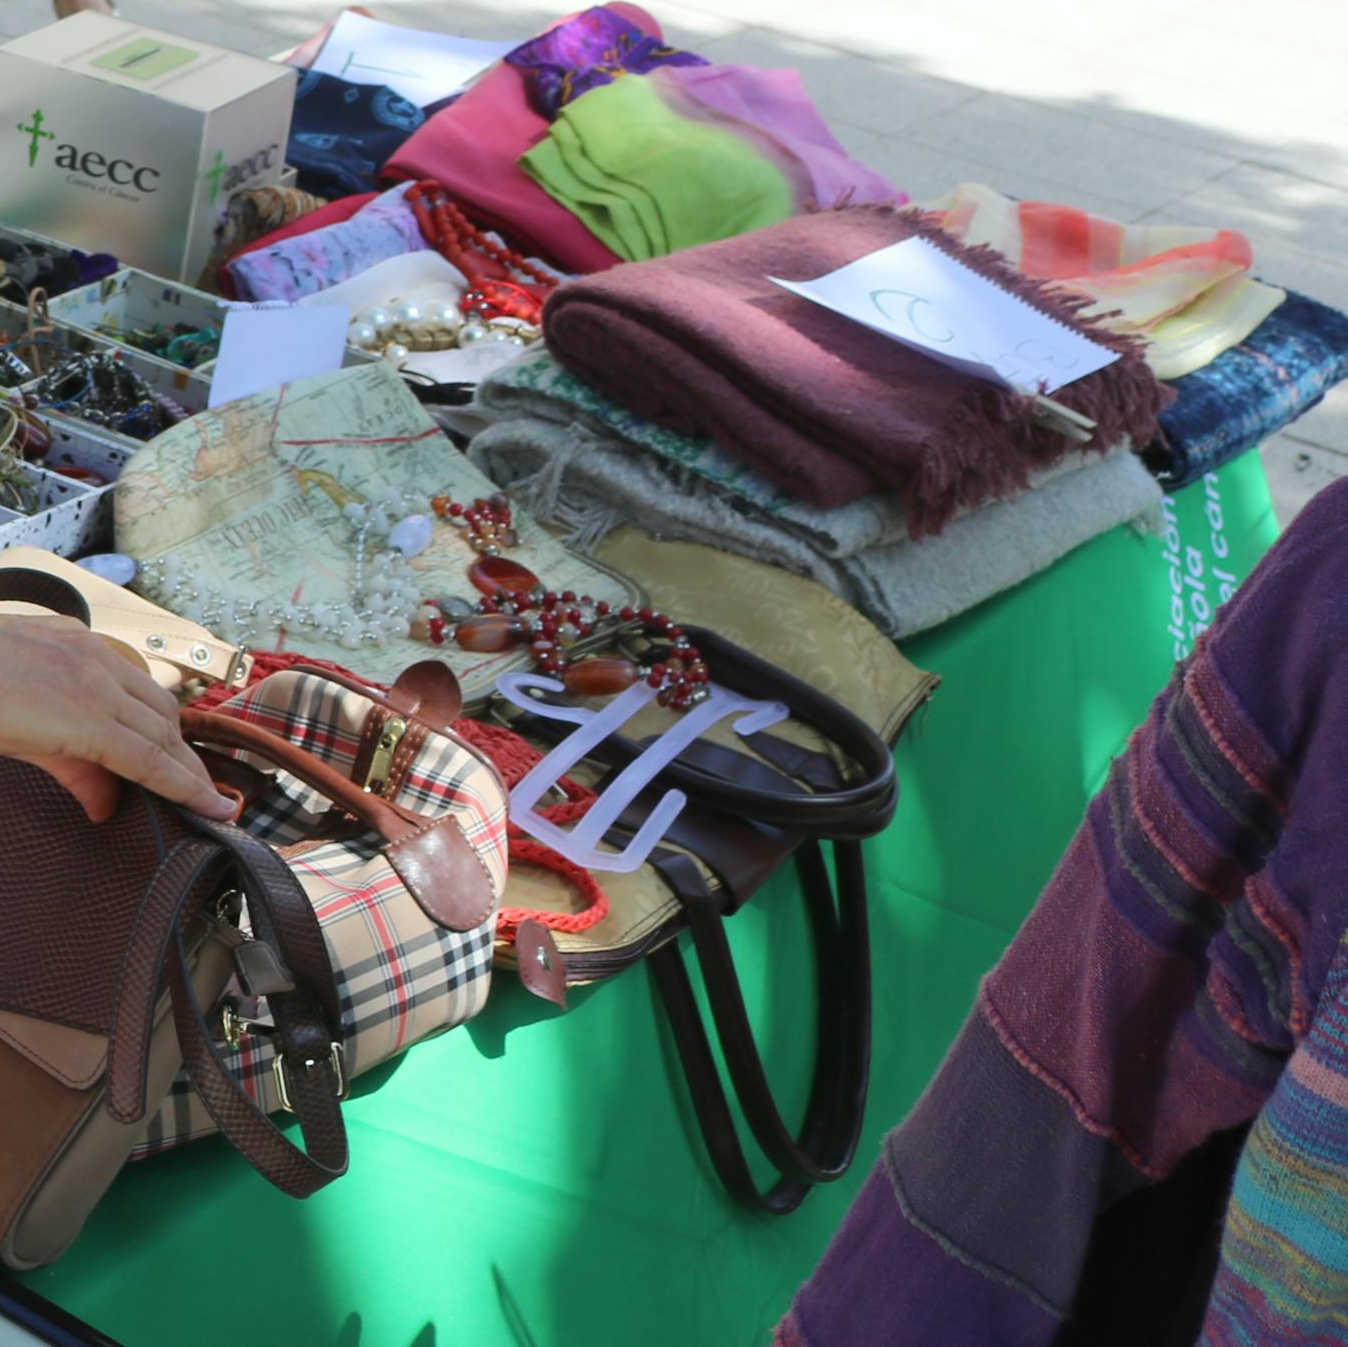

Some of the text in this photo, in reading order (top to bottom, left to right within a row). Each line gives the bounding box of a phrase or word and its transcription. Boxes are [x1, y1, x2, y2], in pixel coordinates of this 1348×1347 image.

[54, 143, 161, 193] aecc
[1204, 471, 1229, 559] can
[1160, 493, 1189, 662] ciación
